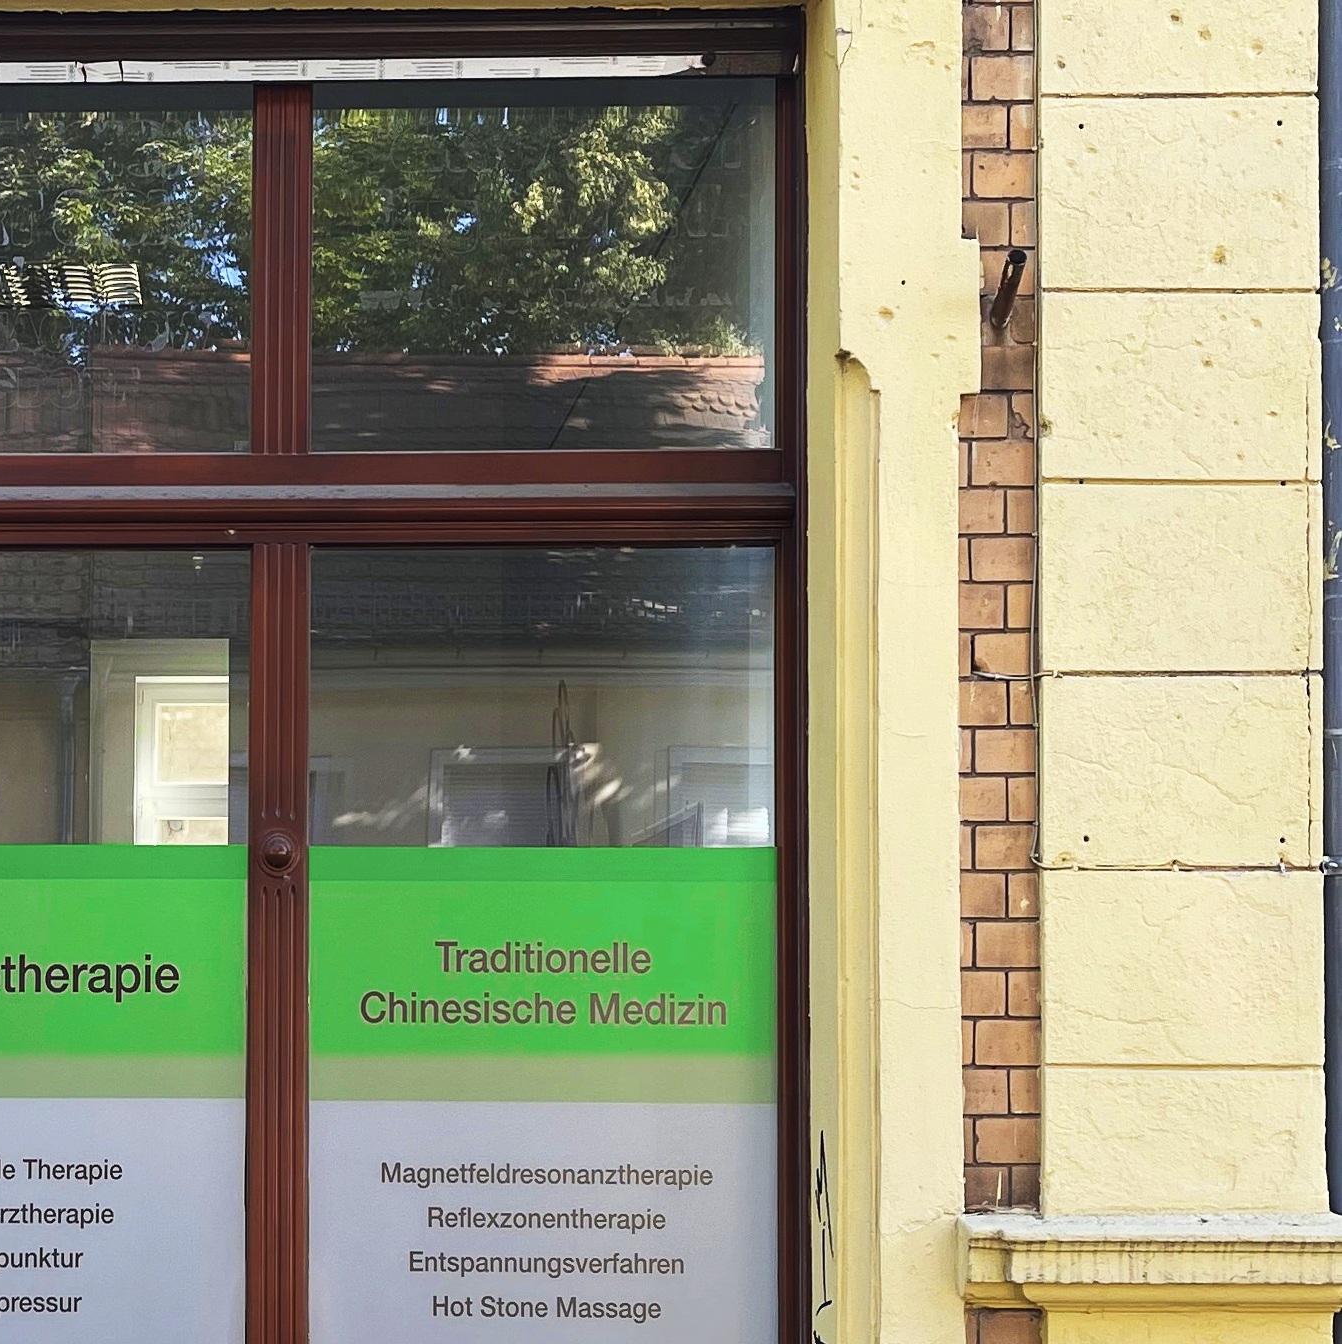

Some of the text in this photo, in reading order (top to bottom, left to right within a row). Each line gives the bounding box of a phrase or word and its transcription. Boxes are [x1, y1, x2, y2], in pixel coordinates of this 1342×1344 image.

[435, 940, 651, 974] Traditionelle
[360, 991, 727, 1026] Chinesische Medizin
[22, 1158, 123, 1186] Therapie
[381, 1161, 714, 1191] Magnetfeldresonanztherapie
[427, 1206, 667, 1235] Reflexzonentherapie
[409, 1250, 685, 1279] Entspannungsverfahren
[433, 1295, 662, 1325] Hot Stone Massage
